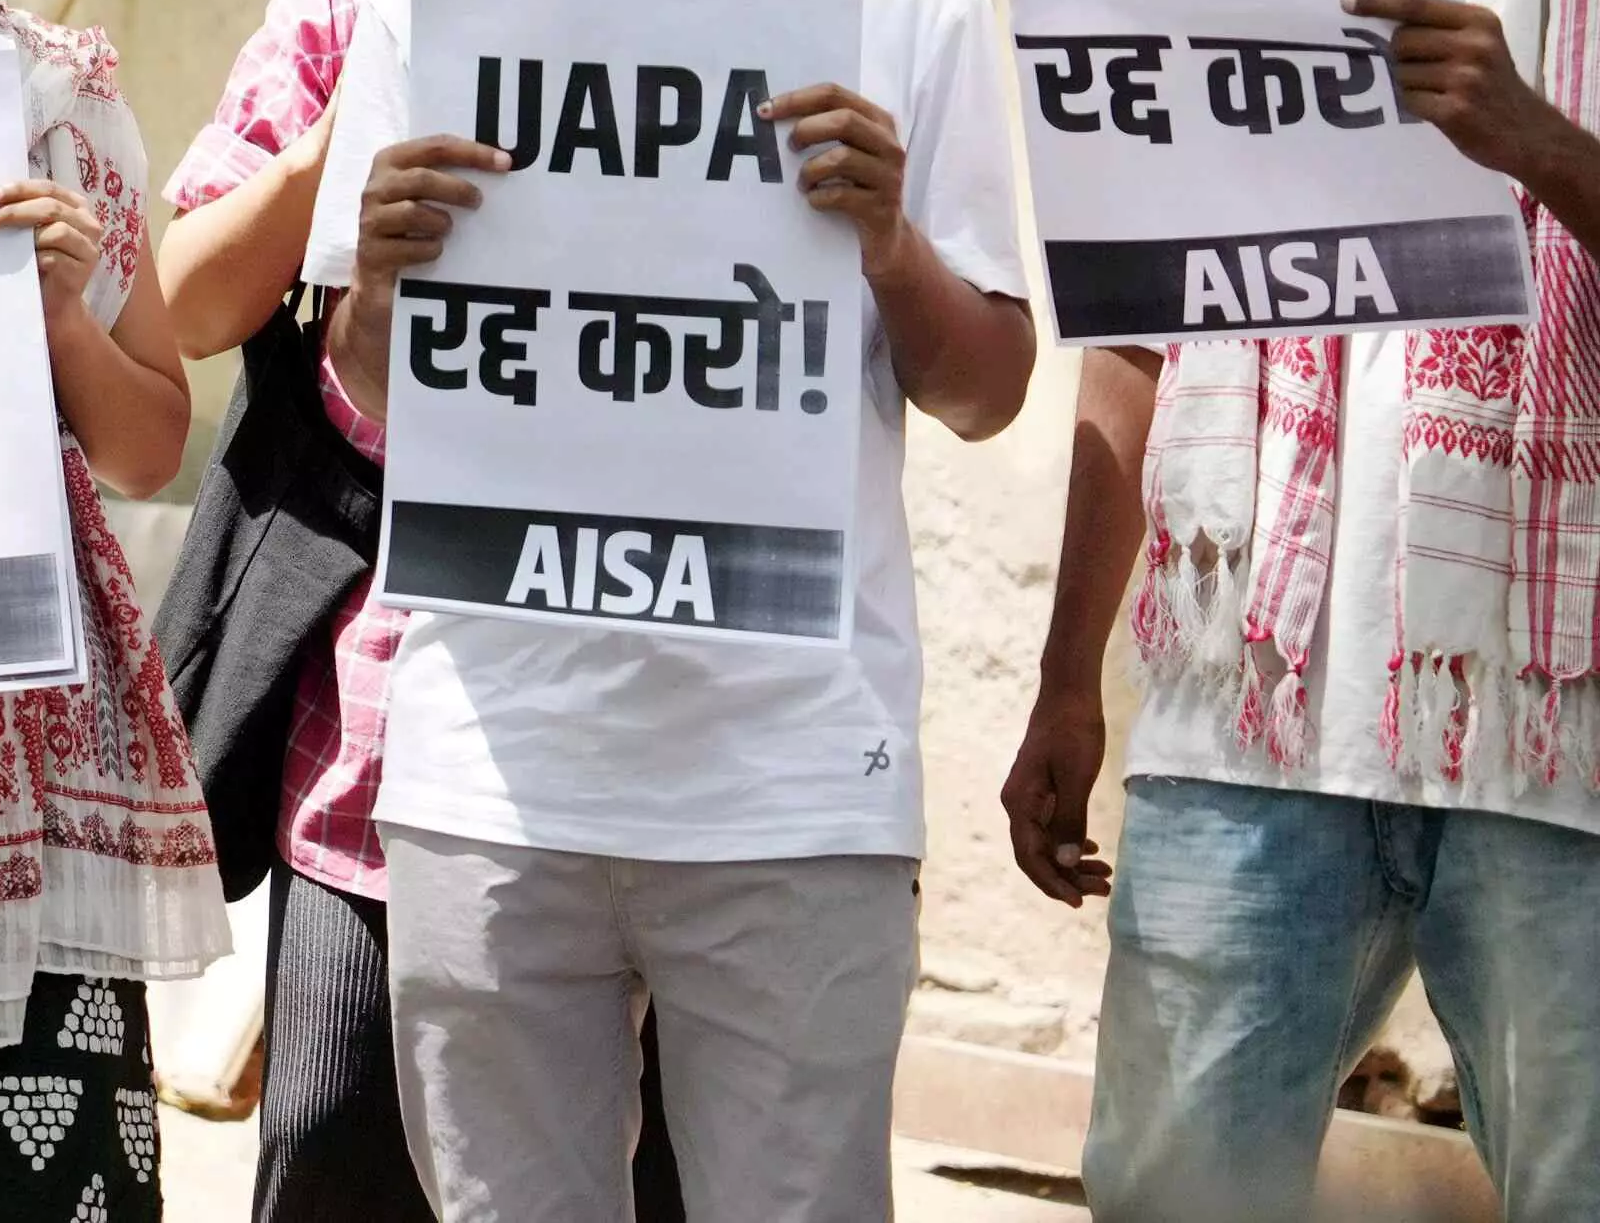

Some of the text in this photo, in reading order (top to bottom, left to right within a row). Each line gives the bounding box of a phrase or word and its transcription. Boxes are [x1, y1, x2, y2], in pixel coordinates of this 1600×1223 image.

[475, 55, 785, 184] UAPA
[1014, 34, 1173, 145] रद्द
[1182, 236, 1399, 327] AISA
[399, 263, 830, 416] रद्द करो!
[504, 523, 716, 623] AISA
